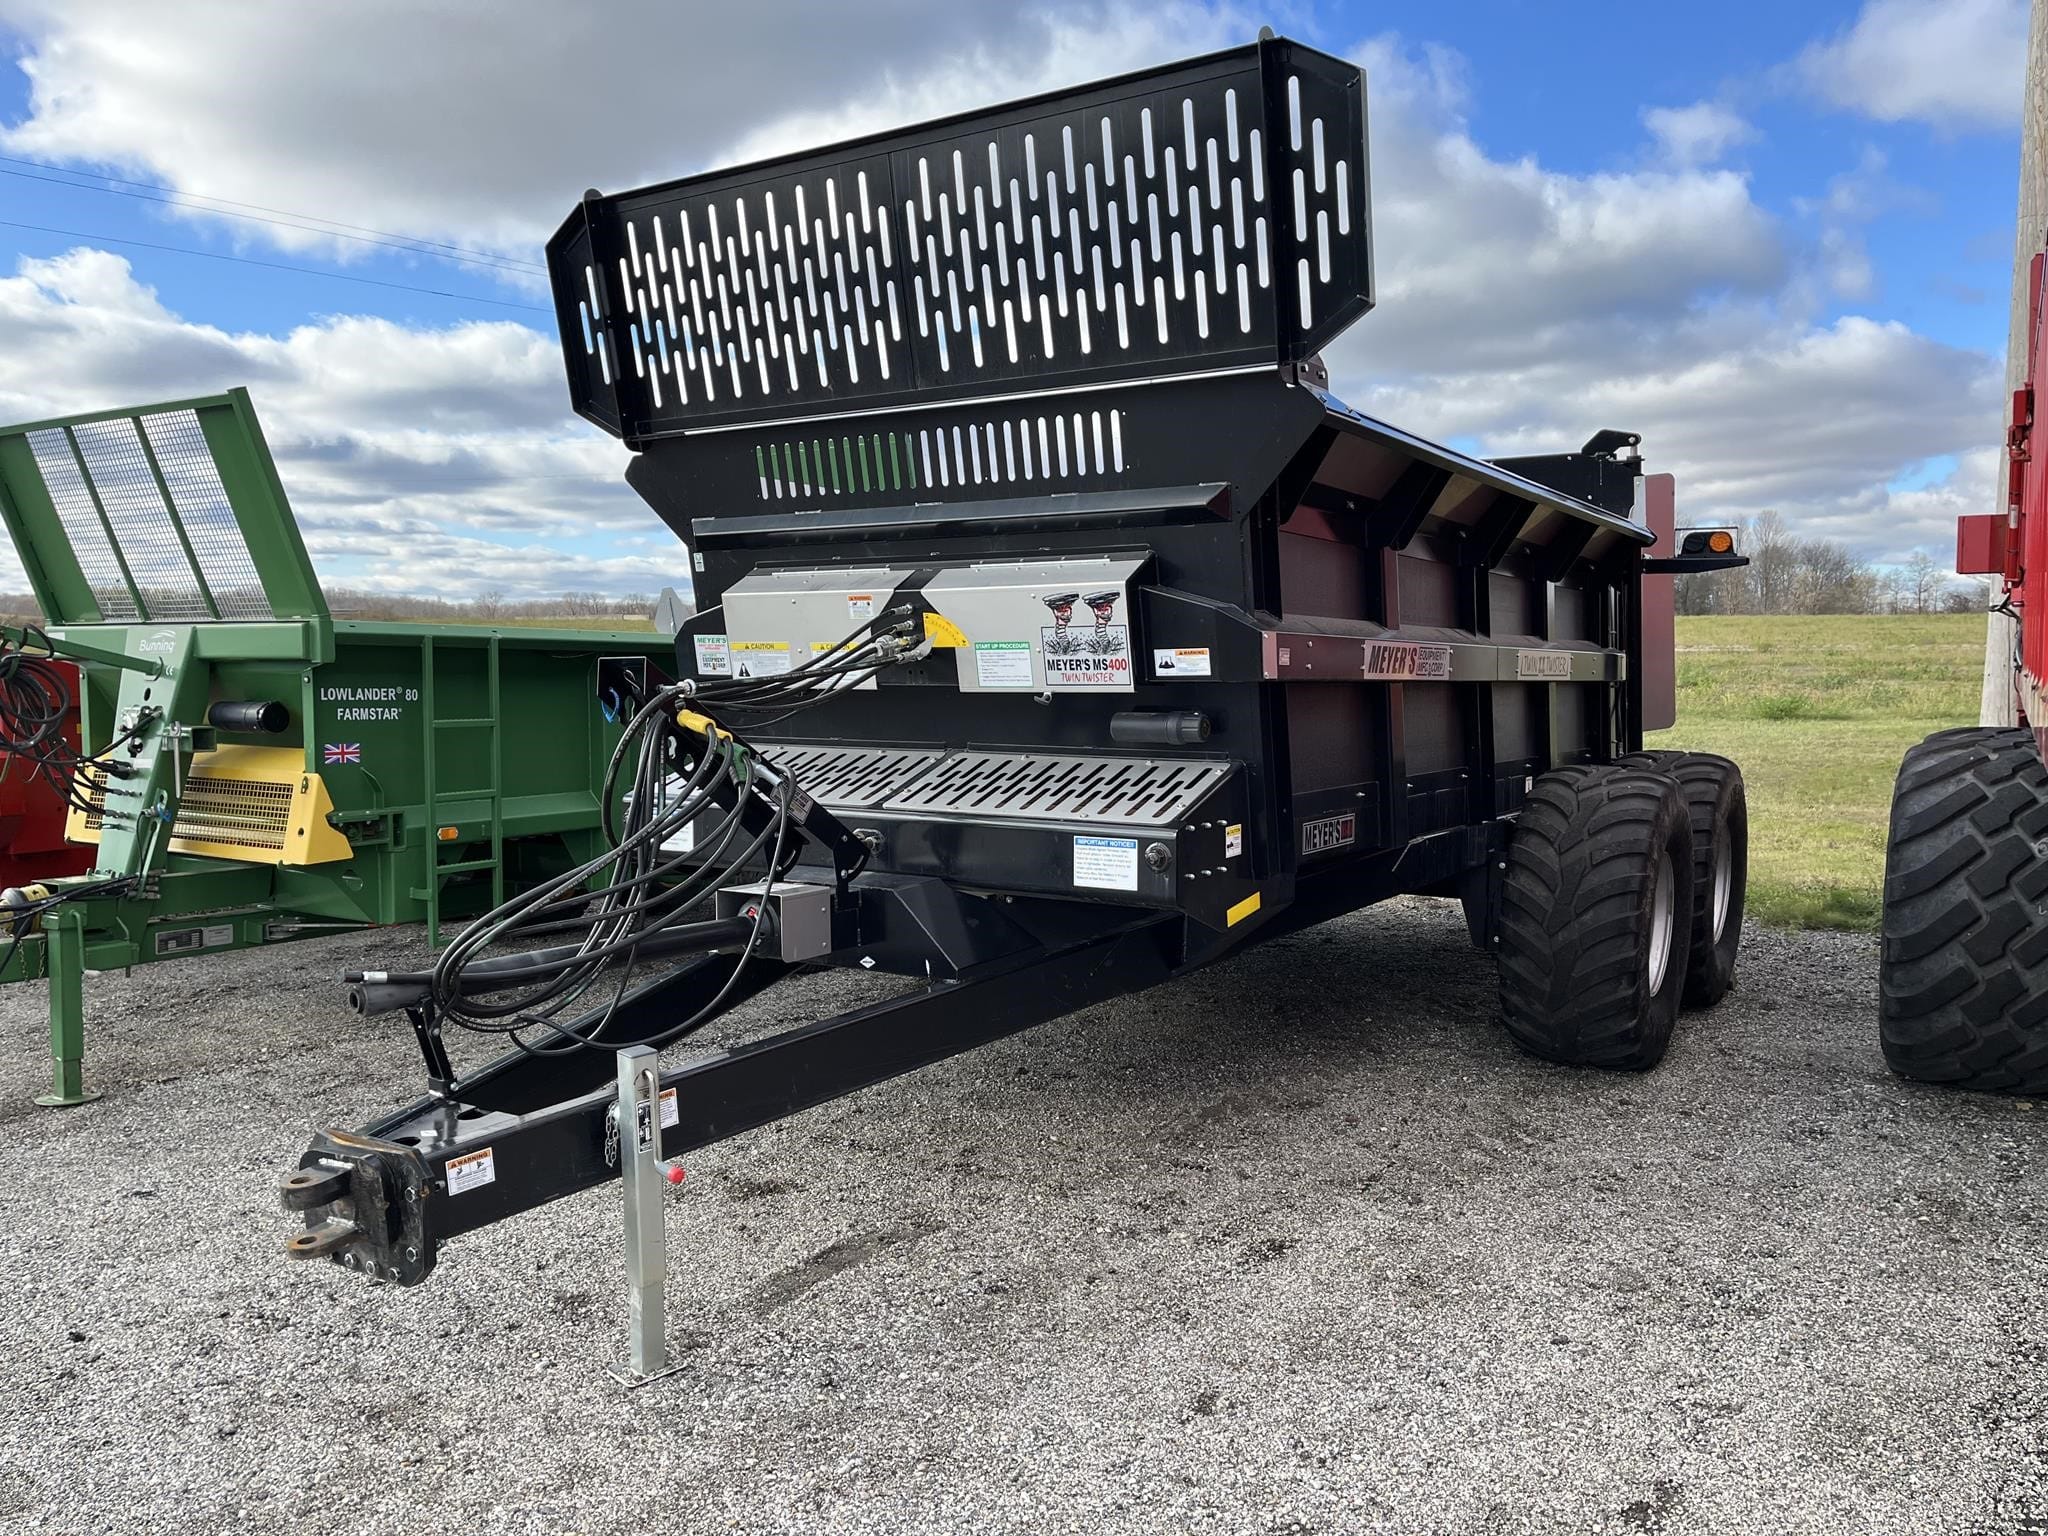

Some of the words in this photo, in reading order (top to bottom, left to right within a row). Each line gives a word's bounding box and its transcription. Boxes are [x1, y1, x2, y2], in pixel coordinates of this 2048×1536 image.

[139, 639, 176, 653] Bunning
[750, 641, 775, 650] CAUTION
[1047, 658, 1091, 672] MEYER'S
[1093, 658, 1128, 672] MS400
[1368, 645, 1418, 675] MEYER'S
[1060, 672, 1081, 683] TWIN
[1082, 672, 1115, 684] TWISTER
[405, 688, 418, 701] 80
[1304, 819, 1341, 851] MEYER'S
[1076, 838, 1108, 847] IMPORTANT
[458, 1151, 488, 1165] WARNING
